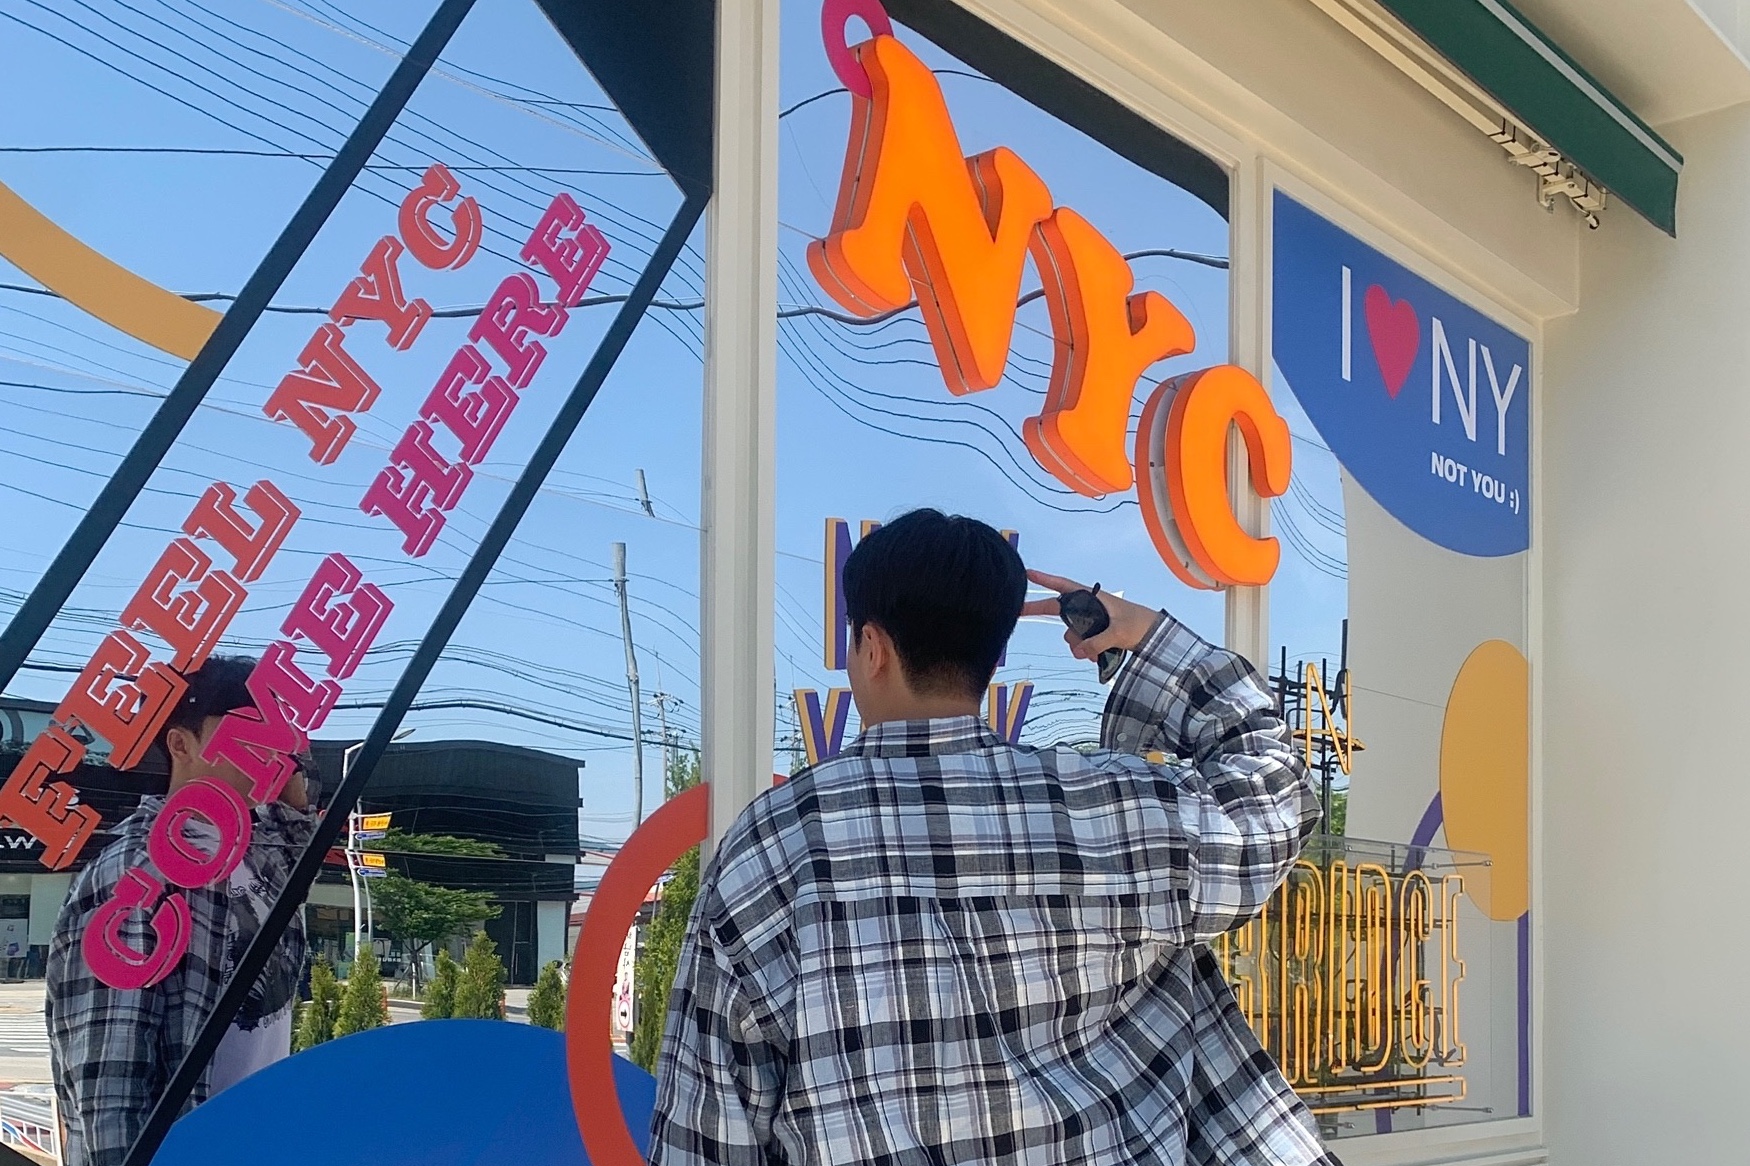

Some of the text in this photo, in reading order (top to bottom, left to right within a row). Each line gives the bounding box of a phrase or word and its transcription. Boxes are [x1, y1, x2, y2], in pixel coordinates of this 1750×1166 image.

[0, 163, 483, 871] FEEL NYC
[81, 192, 612, 989] COME HERE
[806, 33, 1292, 591] NYC
[1430, 450, 1468, 487] NOT
[1470, 468, 1506, 504] YOU
[1431, 316, 1523, 457] NY
